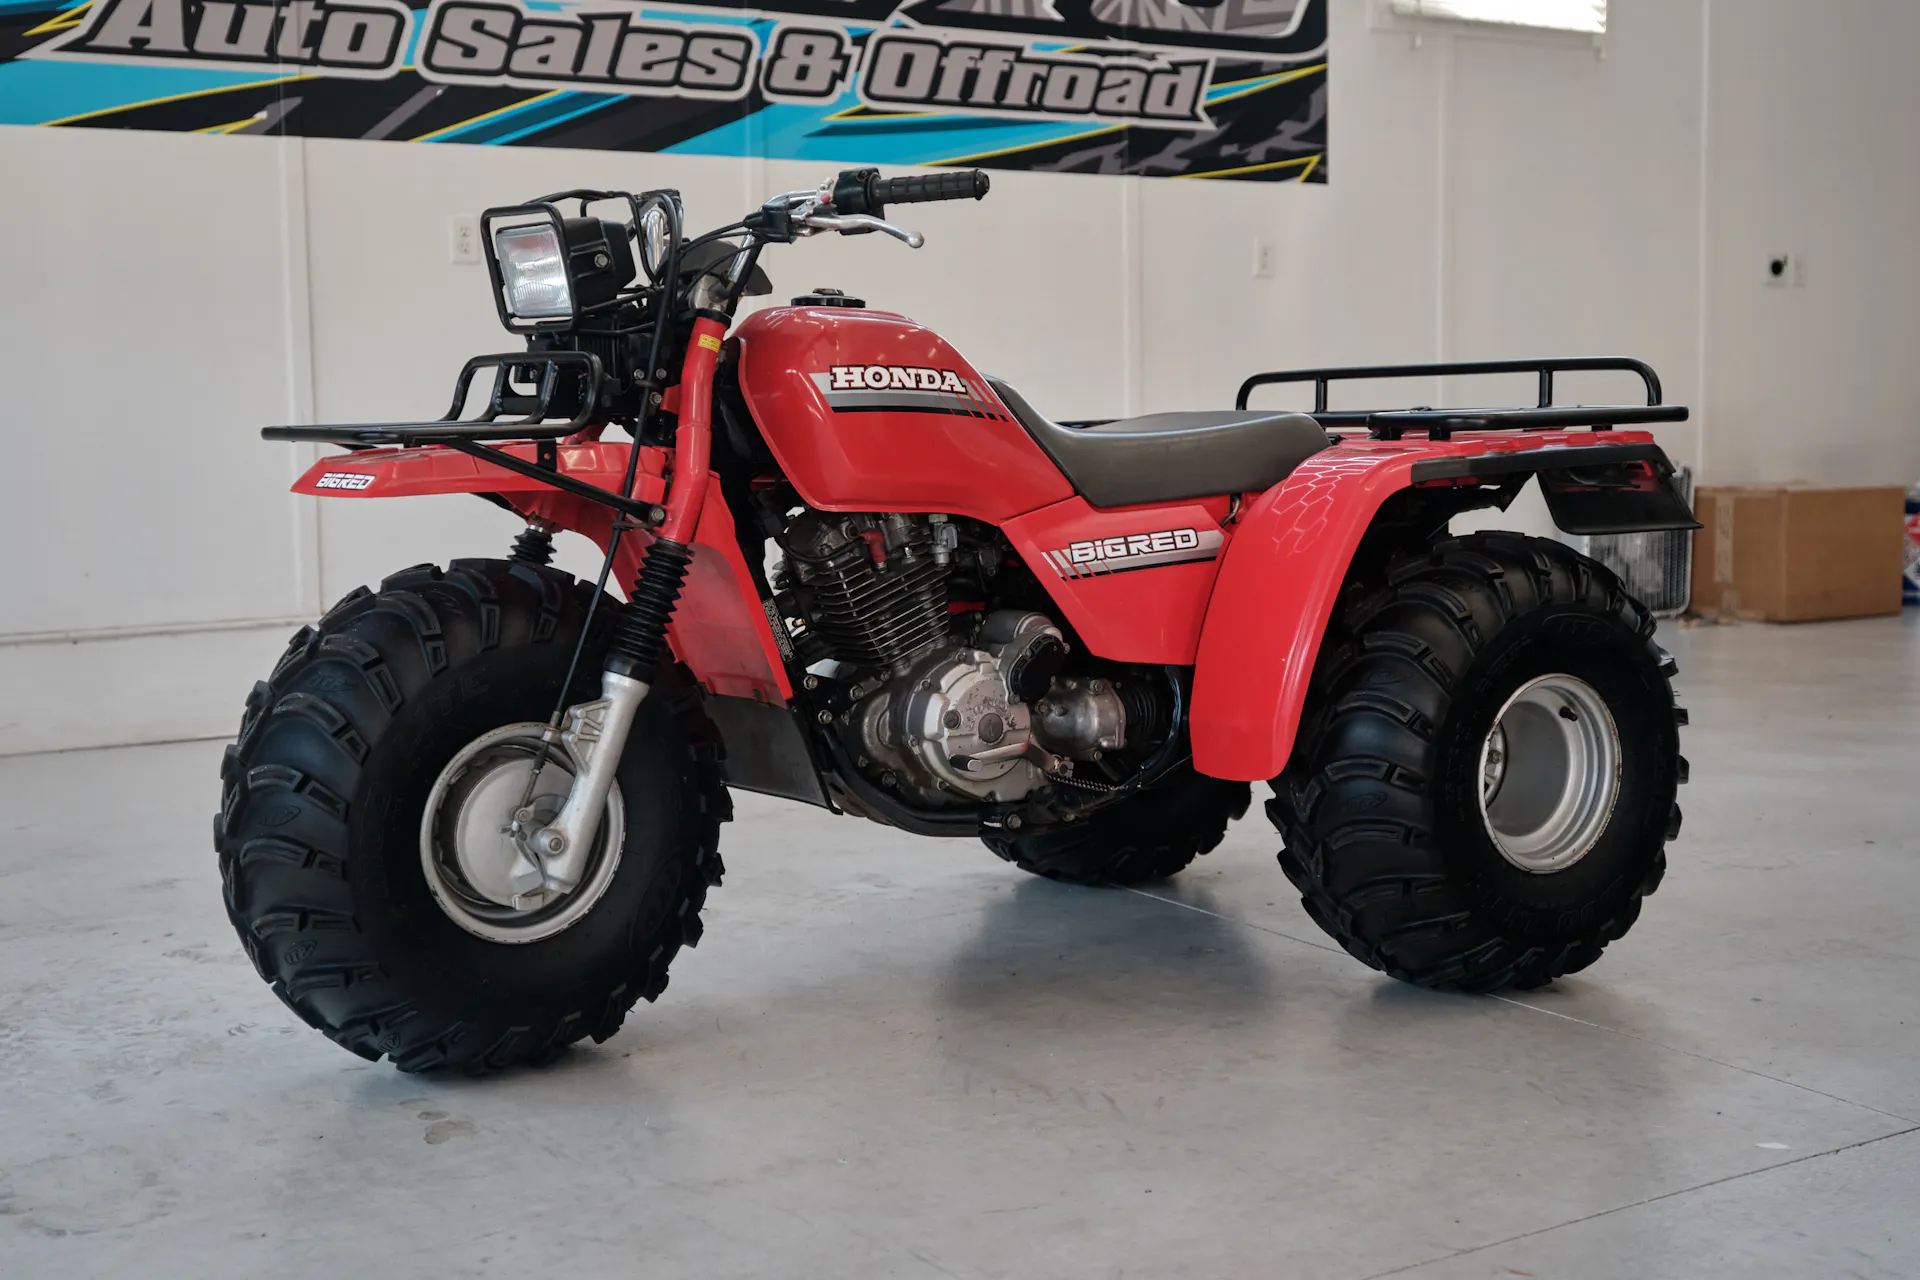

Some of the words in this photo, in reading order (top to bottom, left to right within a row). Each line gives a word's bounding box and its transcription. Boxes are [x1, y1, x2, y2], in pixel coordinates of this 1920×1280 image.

[80, 0, 402, 68] Auto
[427, 3, 752, 89] Sales
[766, 29, 850, 96] &
[865, 37, 1202, 119] Offroad
[830, 365, 968, 394] HONDA
